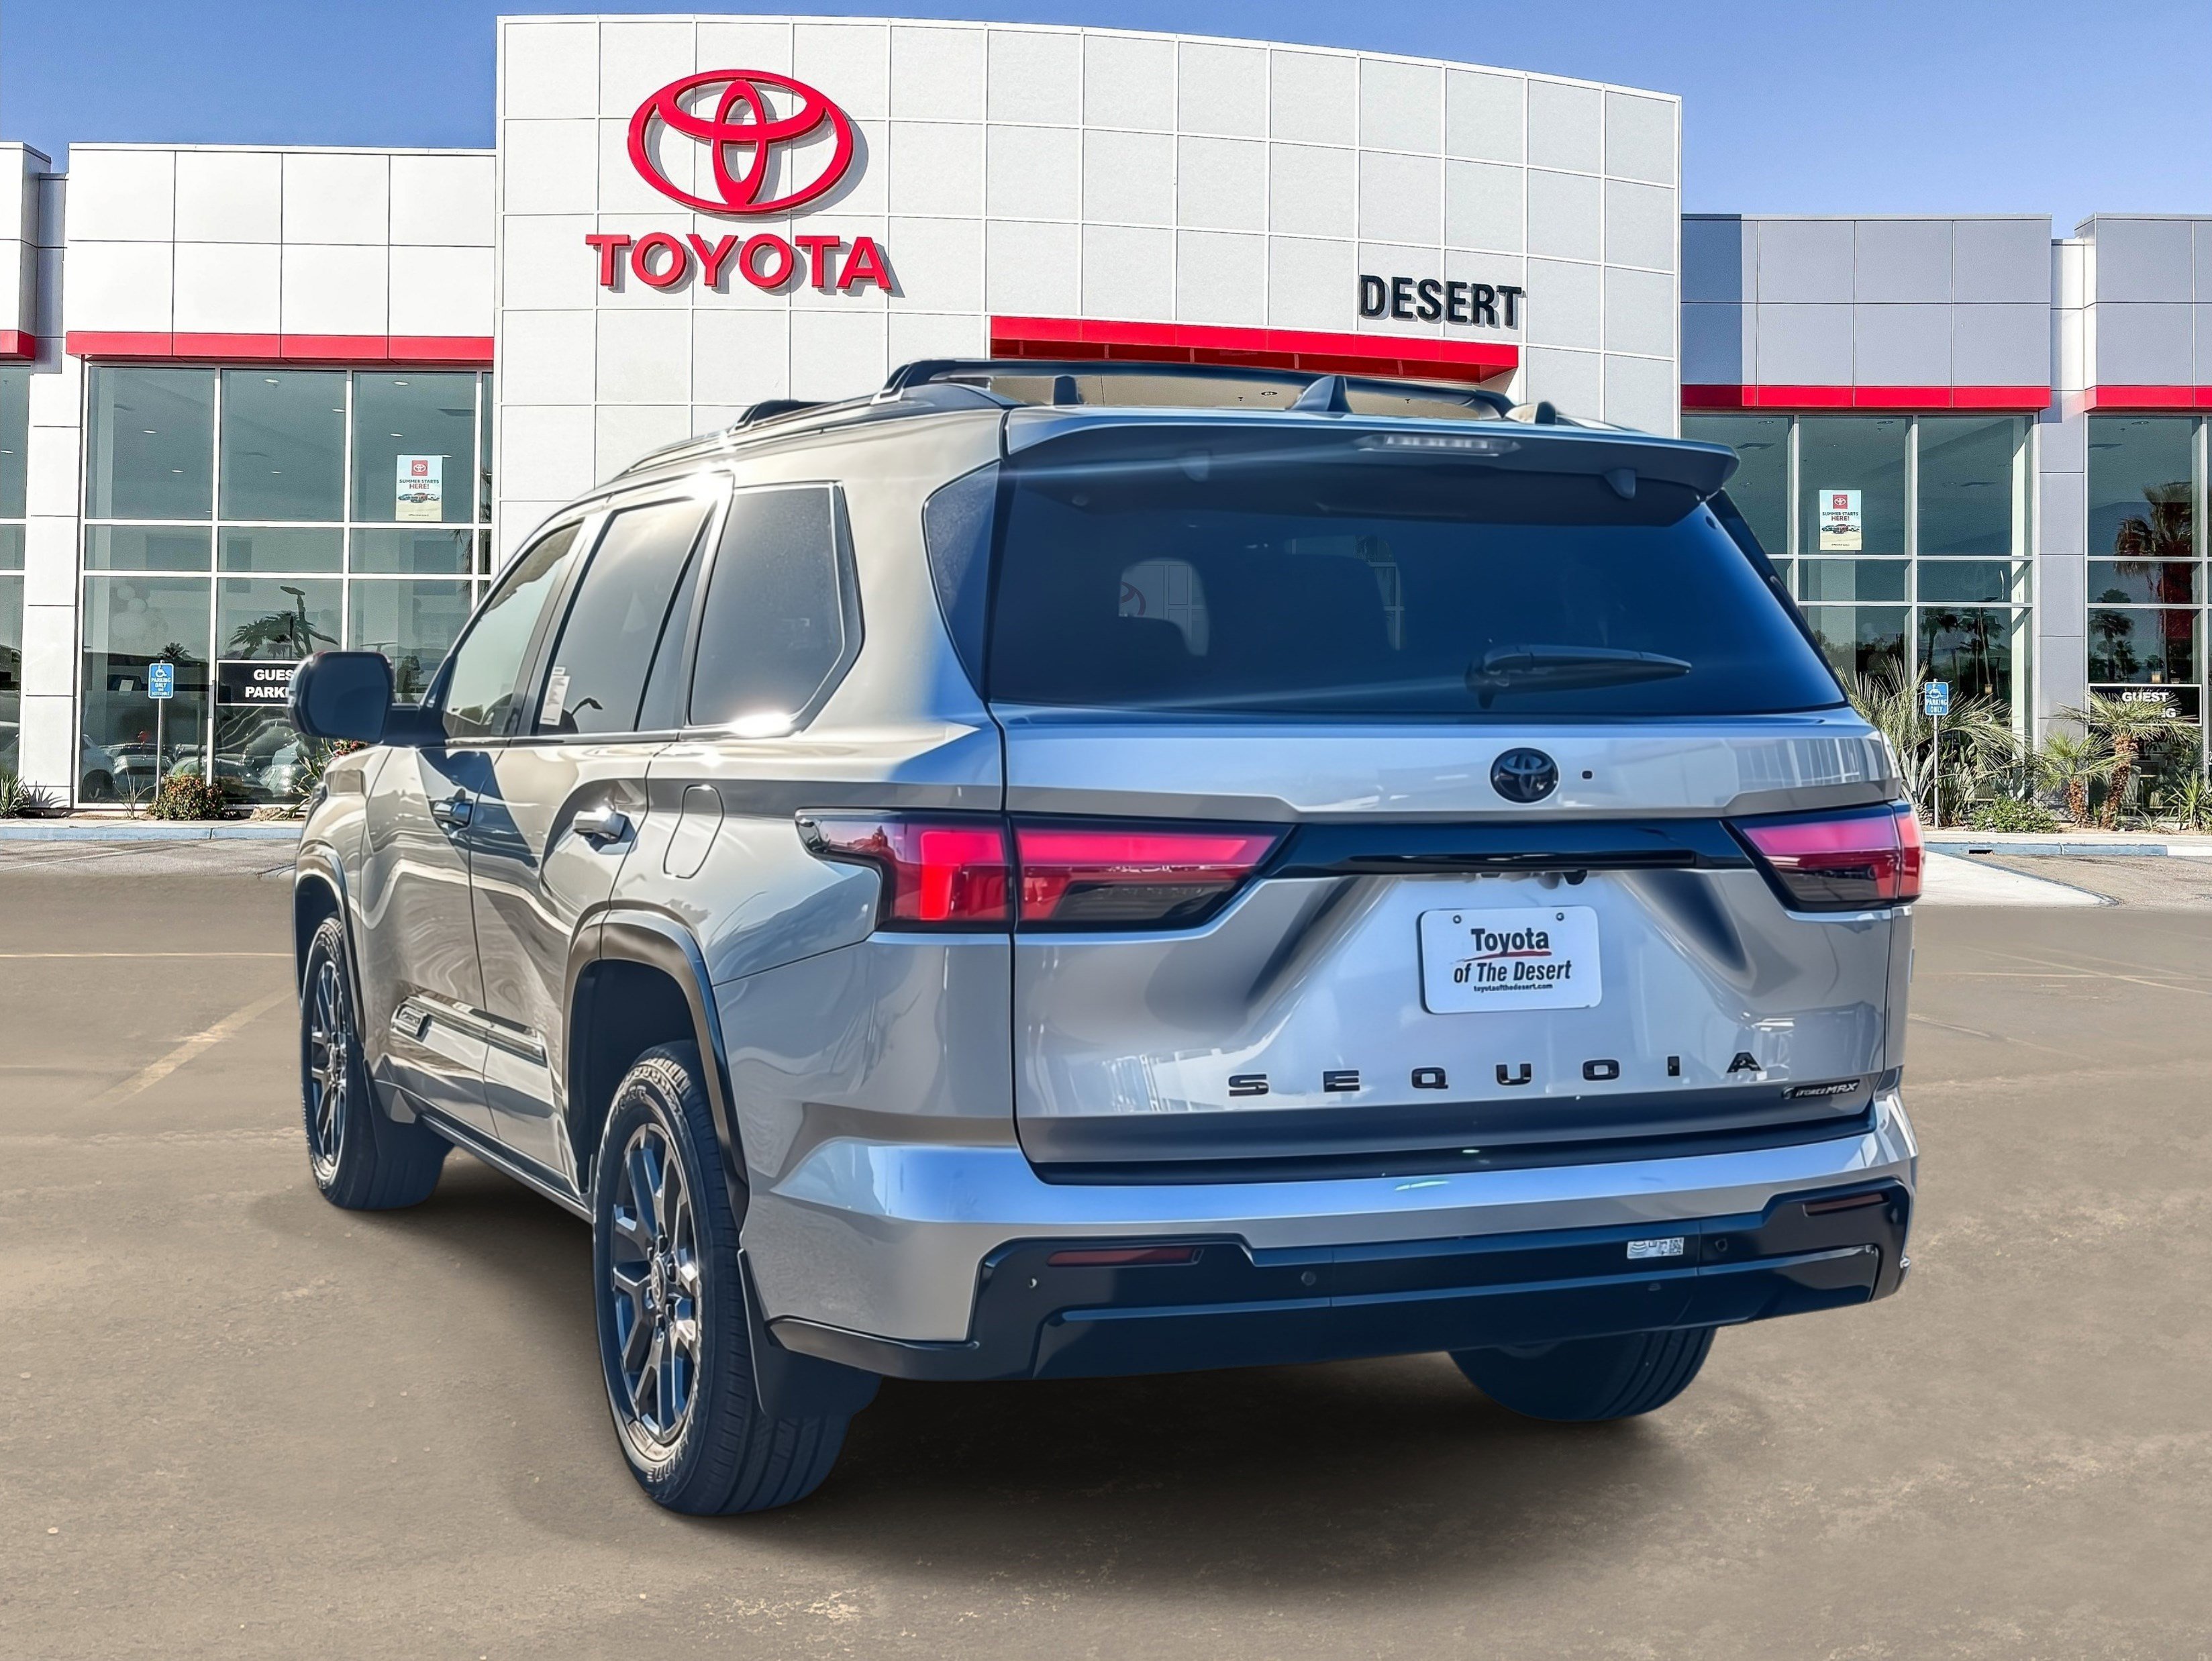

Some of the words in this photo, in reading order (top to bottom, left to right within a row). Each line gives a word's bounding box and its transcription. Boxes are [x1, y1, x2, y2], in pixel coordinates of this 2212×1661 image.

[585, 232, 892, 290] TOYOTA
[1359, 274, 1522, 326] DESERT
[253, 669, 295, 681] GUES
[2122, 692, 2169, 702] GUEST
[1471, 927, 1549, 956] Toyota
[1454, 963, 1472, 983] of
[1477, 962, 1507, 983] The
[1513, 960, 1572, 981] Desert
[1474, 983, 1553, 993] toyotaofthedesert.com
[1228, 1052, 1762, 1097] SEQUOIA
